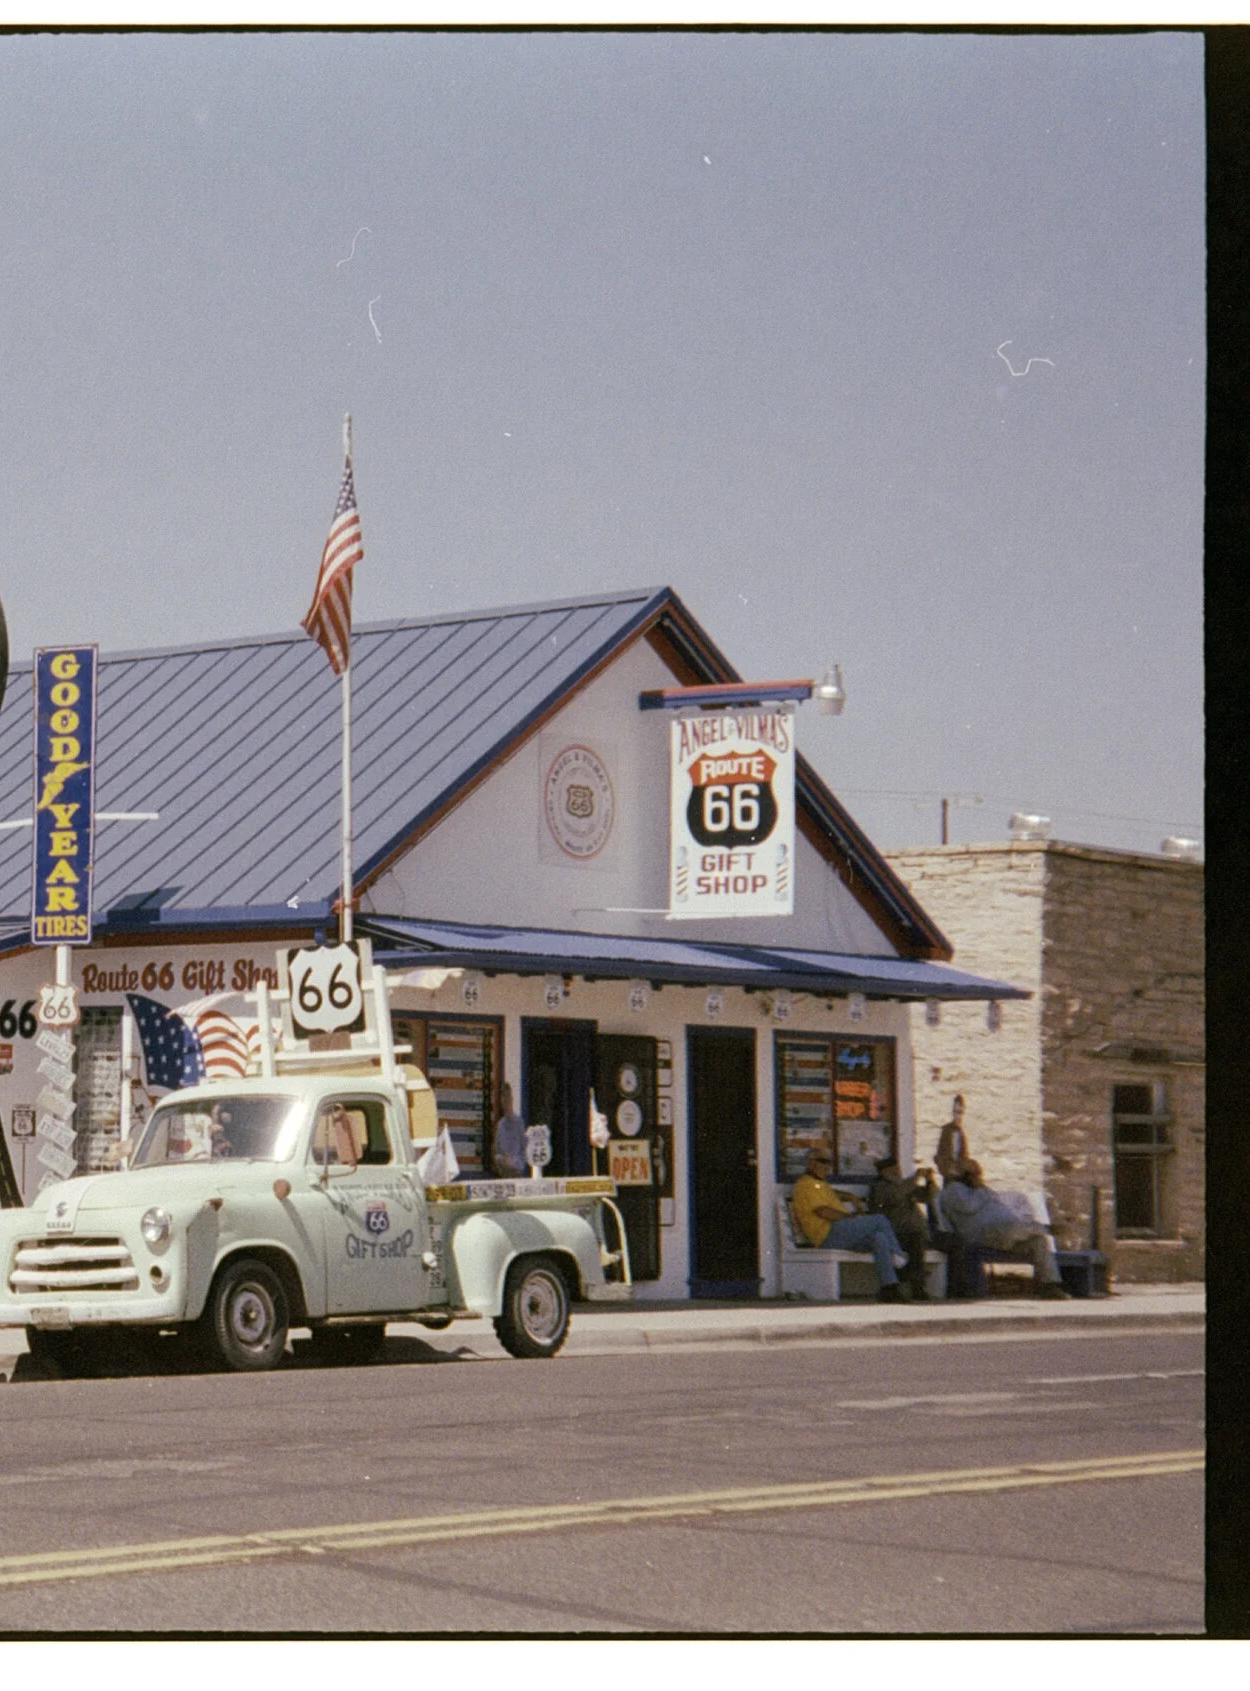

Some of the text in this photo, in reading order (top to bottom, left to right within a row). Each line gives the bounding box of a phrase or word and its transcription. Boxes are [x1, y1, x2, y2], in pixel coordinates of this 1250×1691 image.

[678, 718, 727, 764] ANGEL
[700, 756, 765, 785] ROUTE
[703, 783, 760, 833] 66
[701, 853, 756, 872] GIFT
[697, 875, 767, 895] SHOP
[35, 915, 88, 938] TIRES
[81, 963, 139, 994] Route
[141, 962, 175, 991] 66
[182, 959, 225, 995] Gift
[299, 962, 353, 1013] 66
[43, 996, 71, 1019] 66
[613, 1156, 649, 1180] OPEN
[370, 1210, 386, 1230] 66
[345, 1232, 377, 1259] GIFT
[379, 1229, 414, 1258] SHOP
